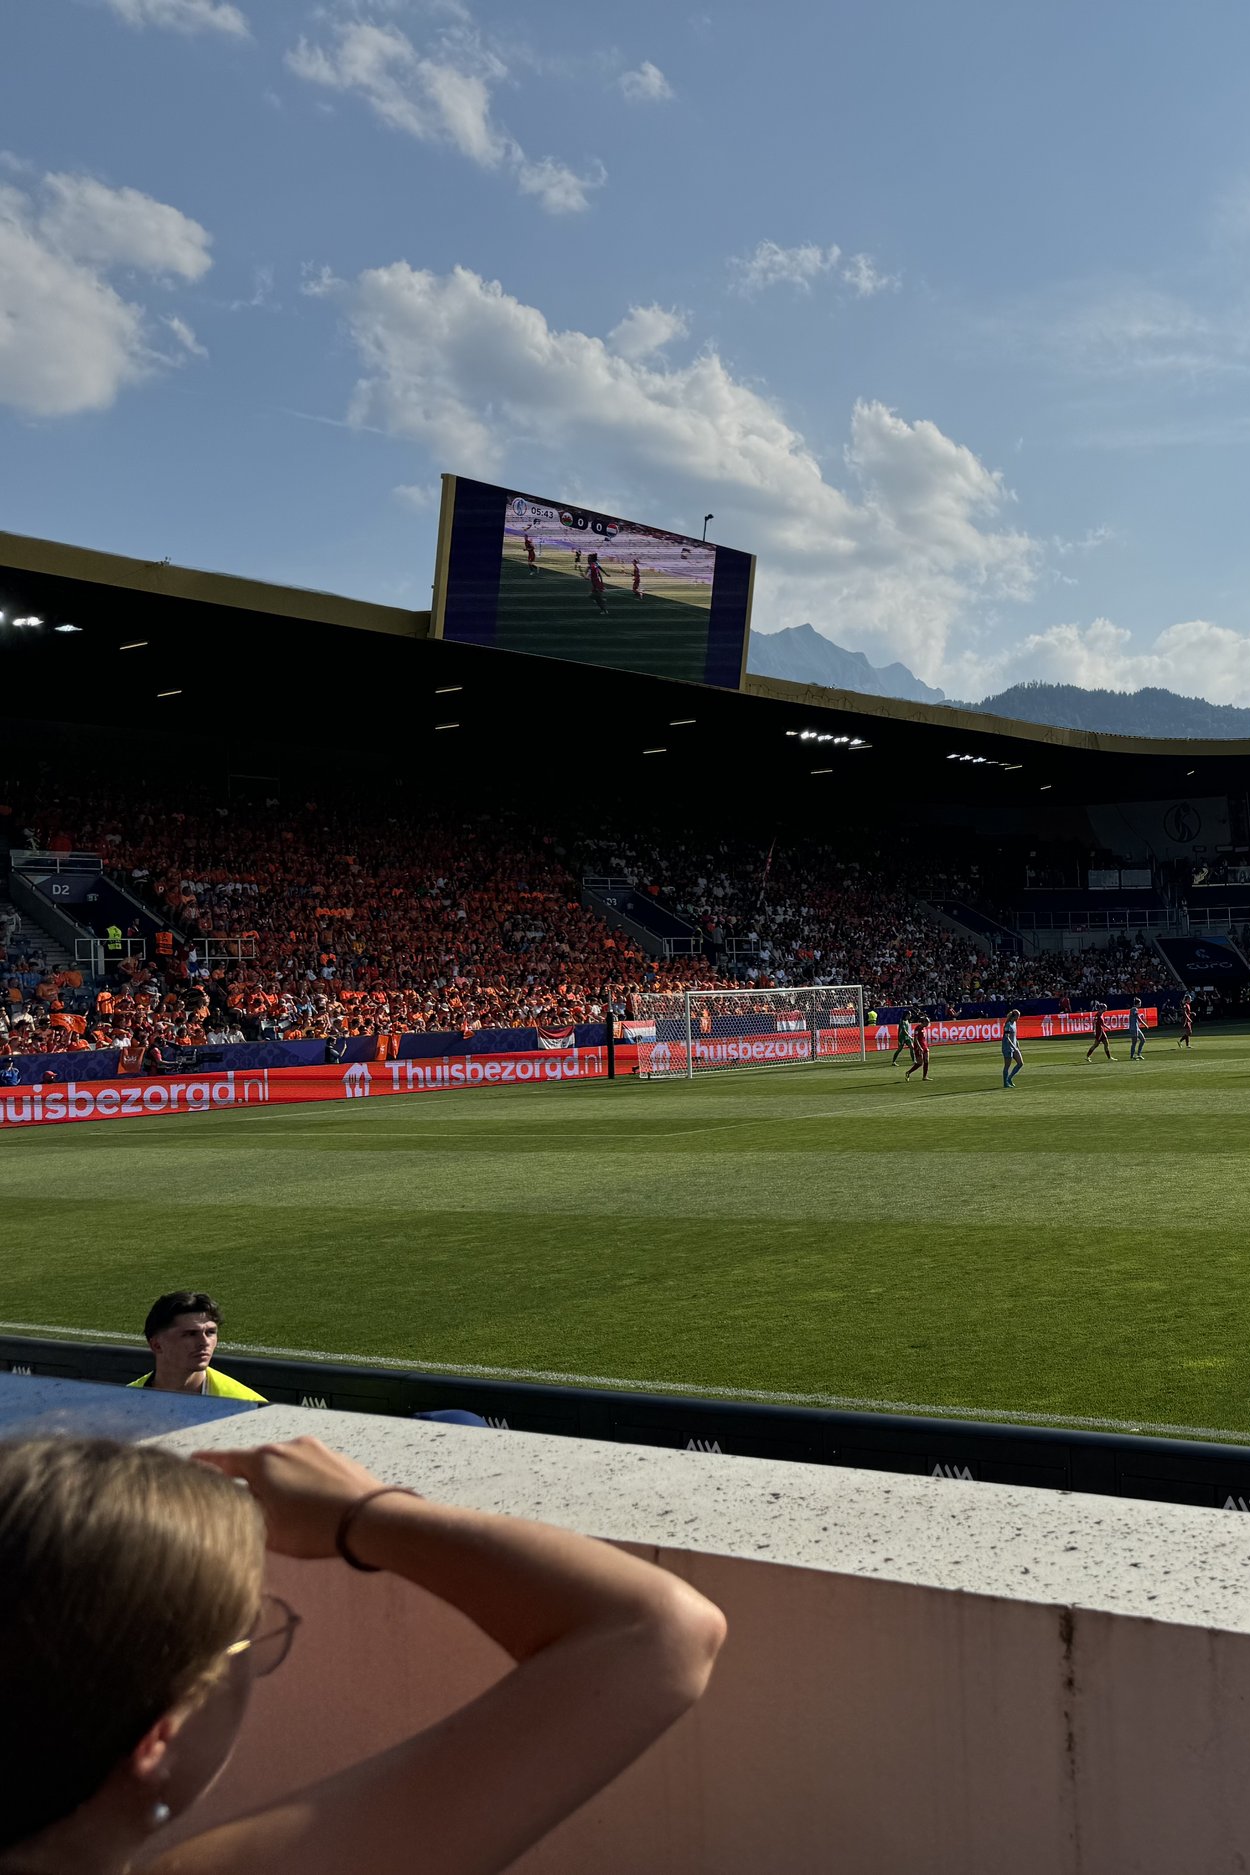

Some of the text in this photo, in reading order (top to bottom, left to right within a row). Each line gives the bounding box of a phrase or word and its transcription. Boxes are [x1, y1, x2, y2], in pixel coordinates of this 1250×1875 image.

[531, 506, 554, 520] 05:43
[577, 518, 603, 533] 0 0
[52, 884, 70, 896] D2
[385, 1046, 602, 1090] Thuisbezorgd.nl
